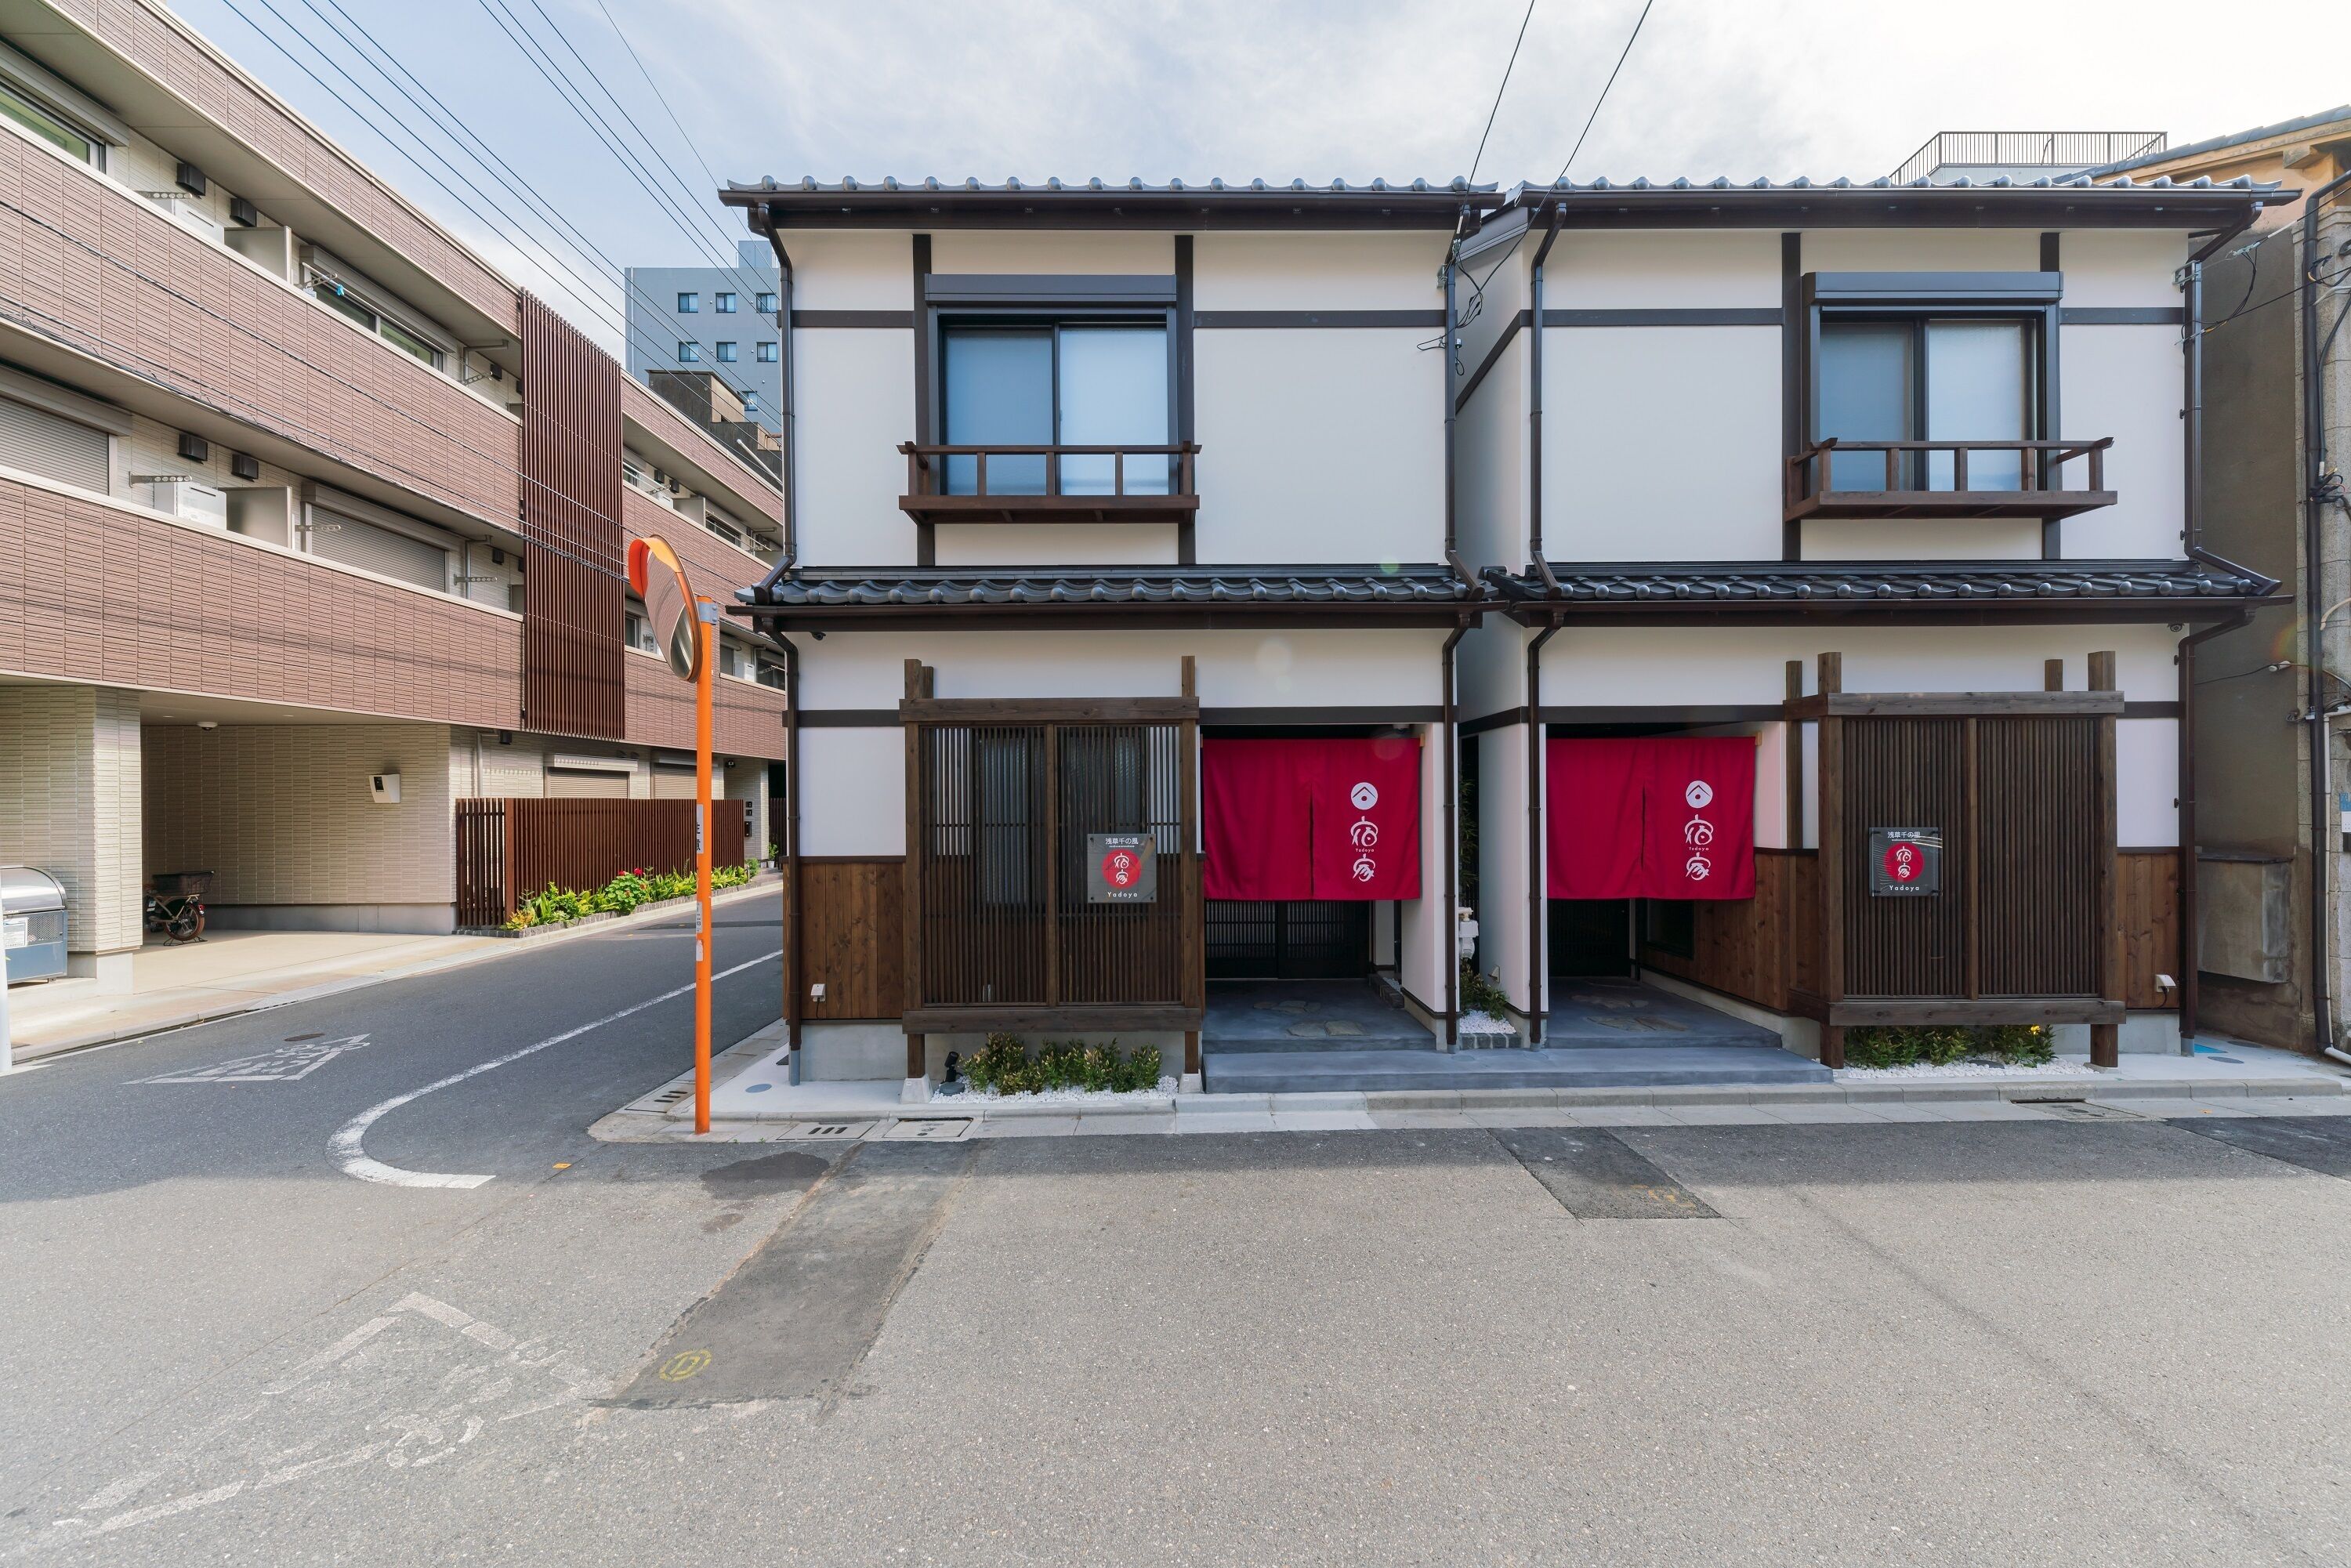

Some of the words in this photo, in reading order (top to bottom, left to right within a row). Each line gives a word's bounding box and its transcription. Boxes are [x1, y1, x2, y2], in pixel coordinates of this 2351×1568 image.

[1105, 837, 1139, 846] 浅草千の風
